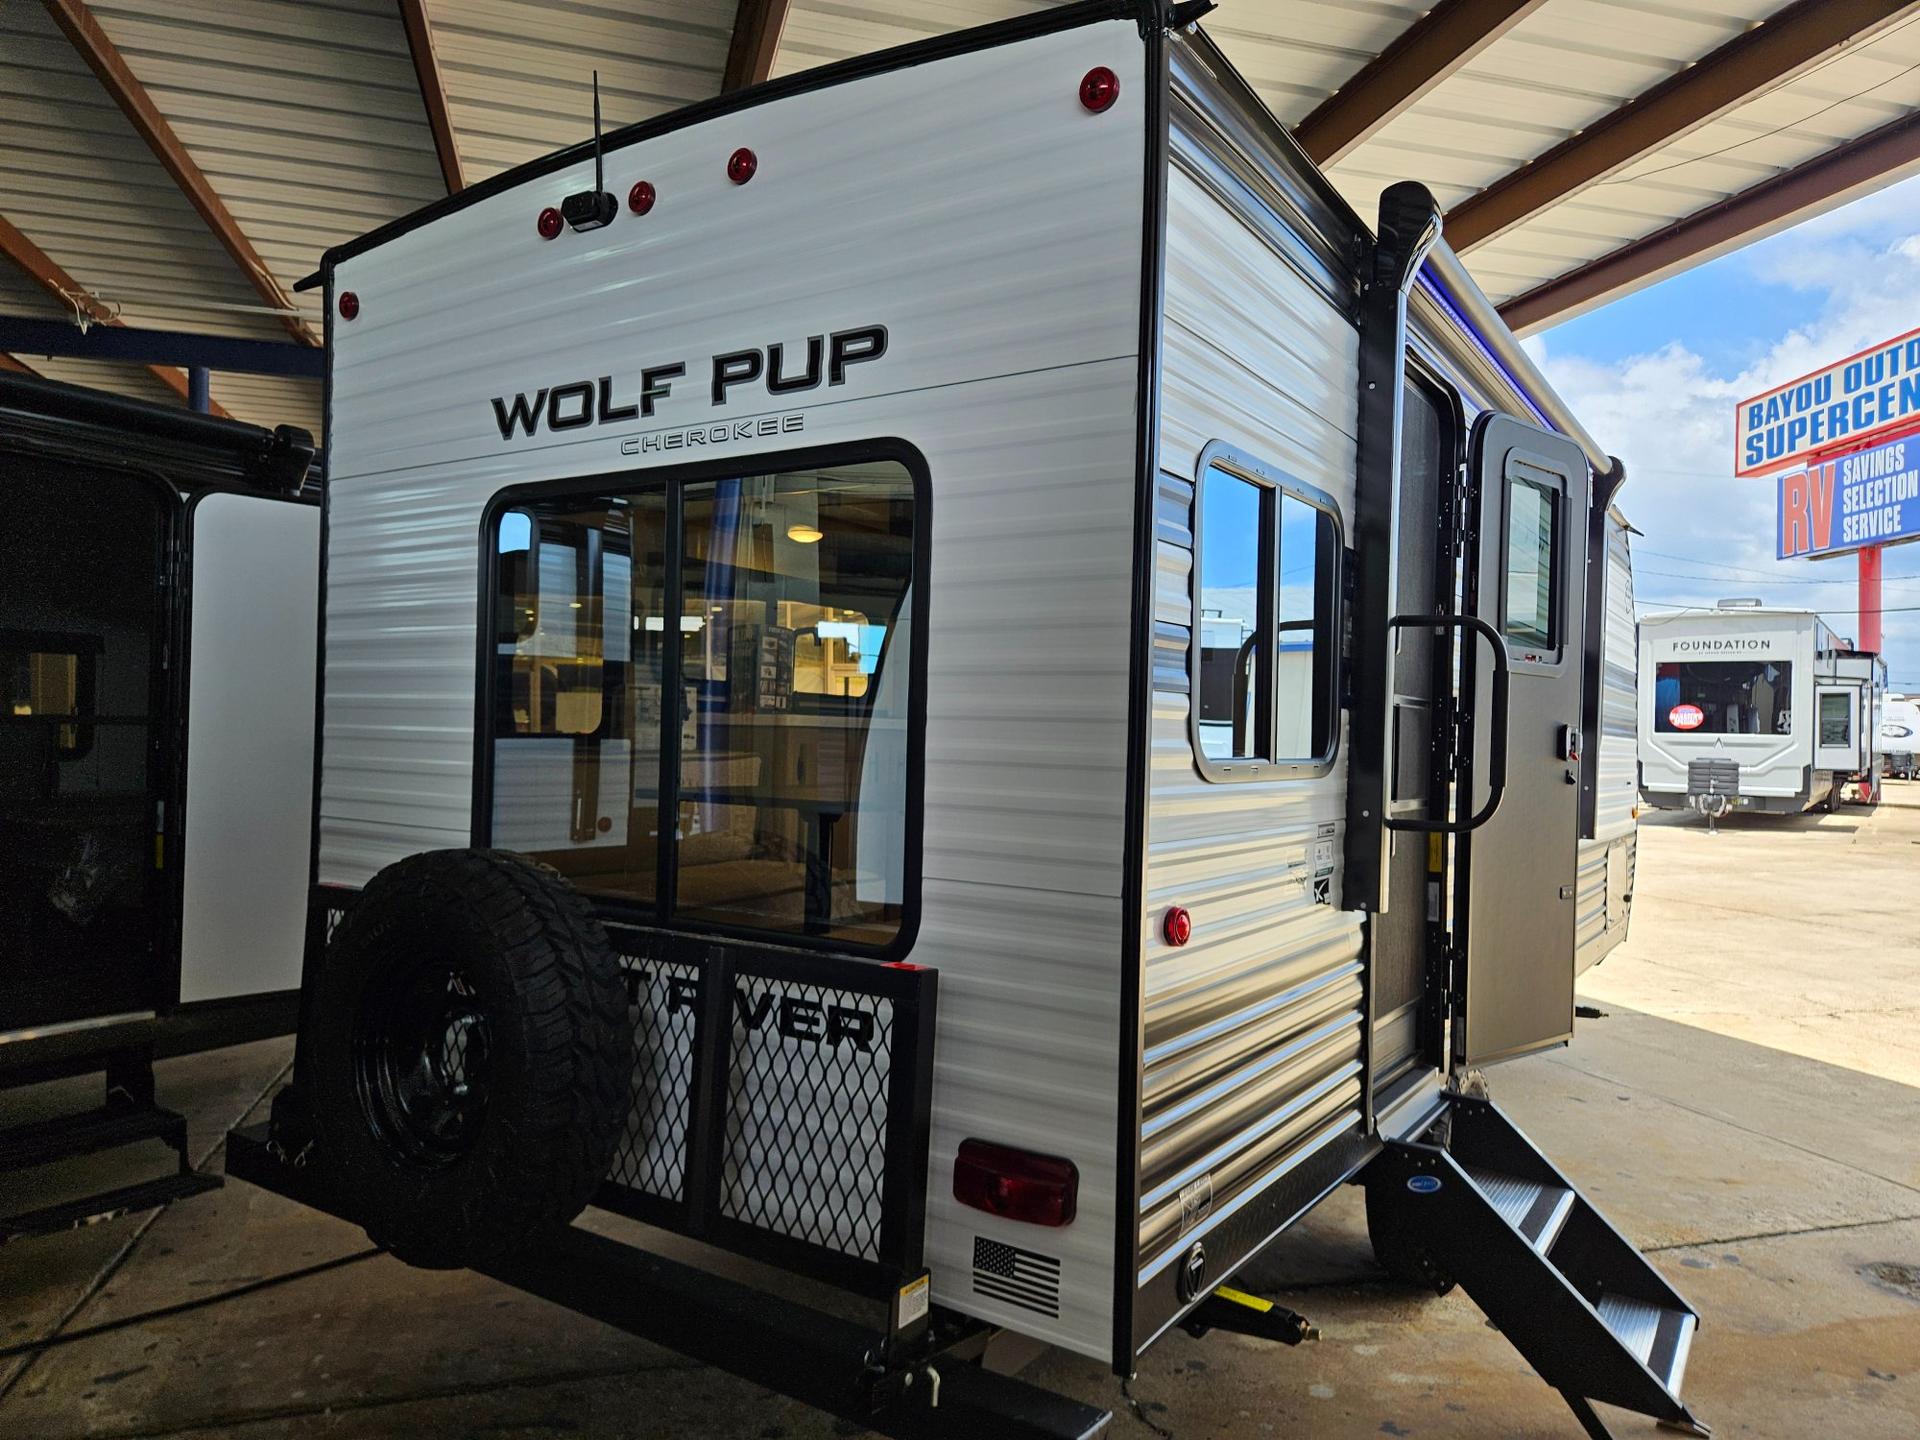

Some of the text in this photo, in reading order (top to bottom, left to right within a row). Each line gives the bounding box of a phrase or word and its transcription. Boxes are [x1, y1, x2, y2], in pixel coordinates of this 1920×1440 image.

[491, 324, 889, 441] WOLF PUP
[1749, 373, 1832, 432] BAYOU
[620, 413, 805, 456] CHEROKEE
[1745, 373, 1920, 466] SUPERCEN
[1843, 443, 1905, 486] SAVINGS
[1782, 462, 1836, 557] RV
[1843, 470, 1918, 514] SELECTION
[1842, 505, 1902, 543] SERVICE
[1672, 640, 1770, 652] FOUNDATION
